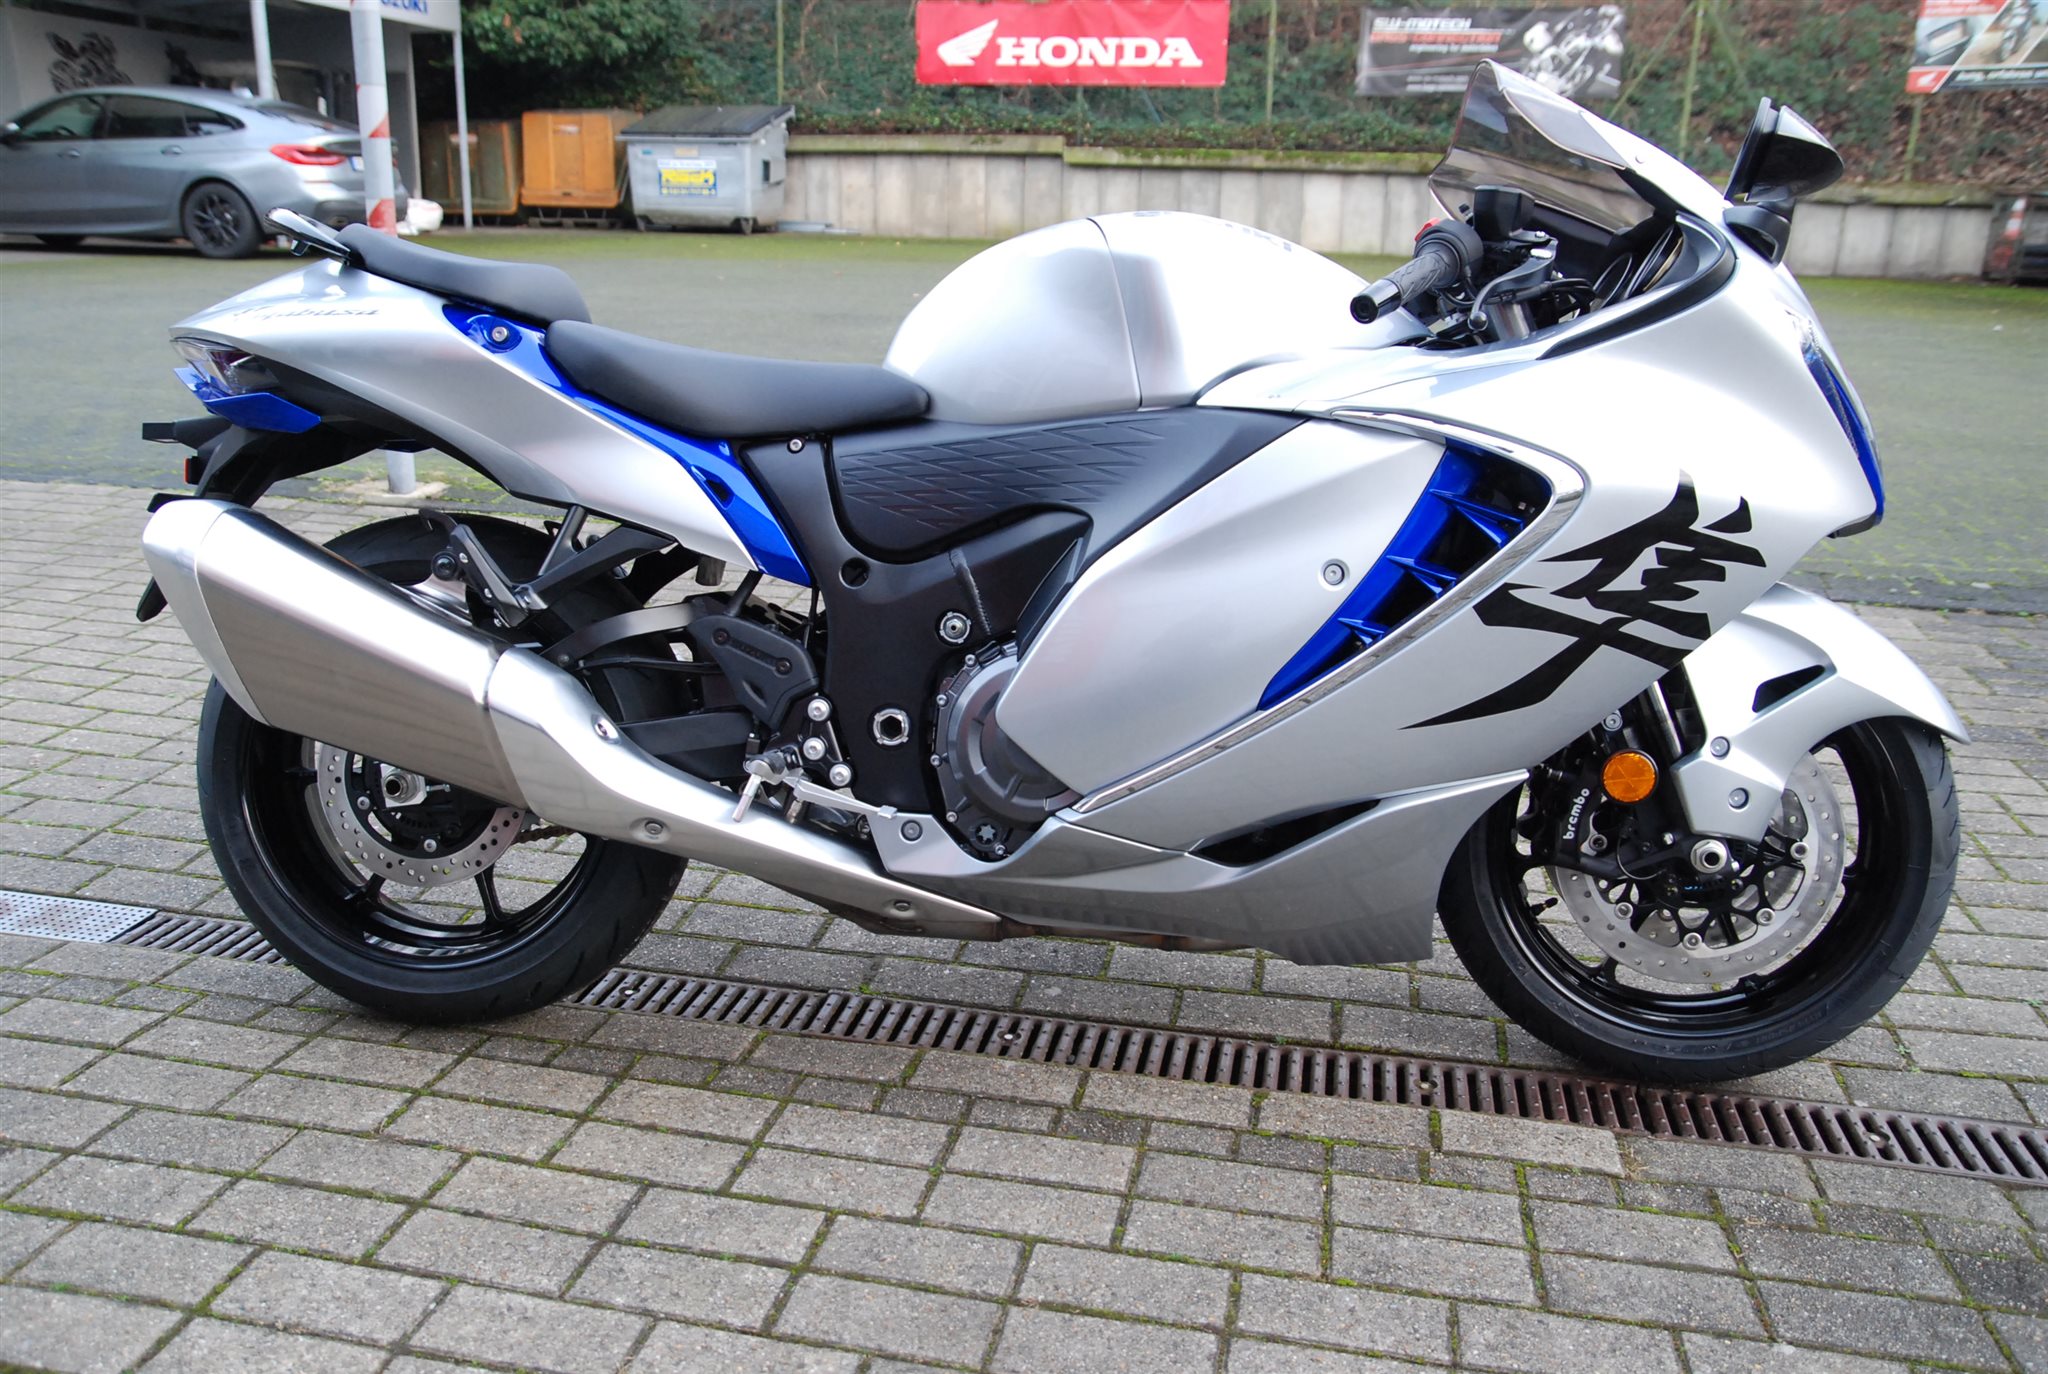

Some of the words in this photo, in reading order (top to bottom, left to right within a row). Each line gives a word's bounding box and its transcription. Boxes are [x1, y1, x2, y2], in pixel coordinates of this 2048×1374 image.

[995, 36, 1203, 67] HONDA
[233, 305, 379, 320] Hyabusa
[1563, 788, 1590, 840] brembo
